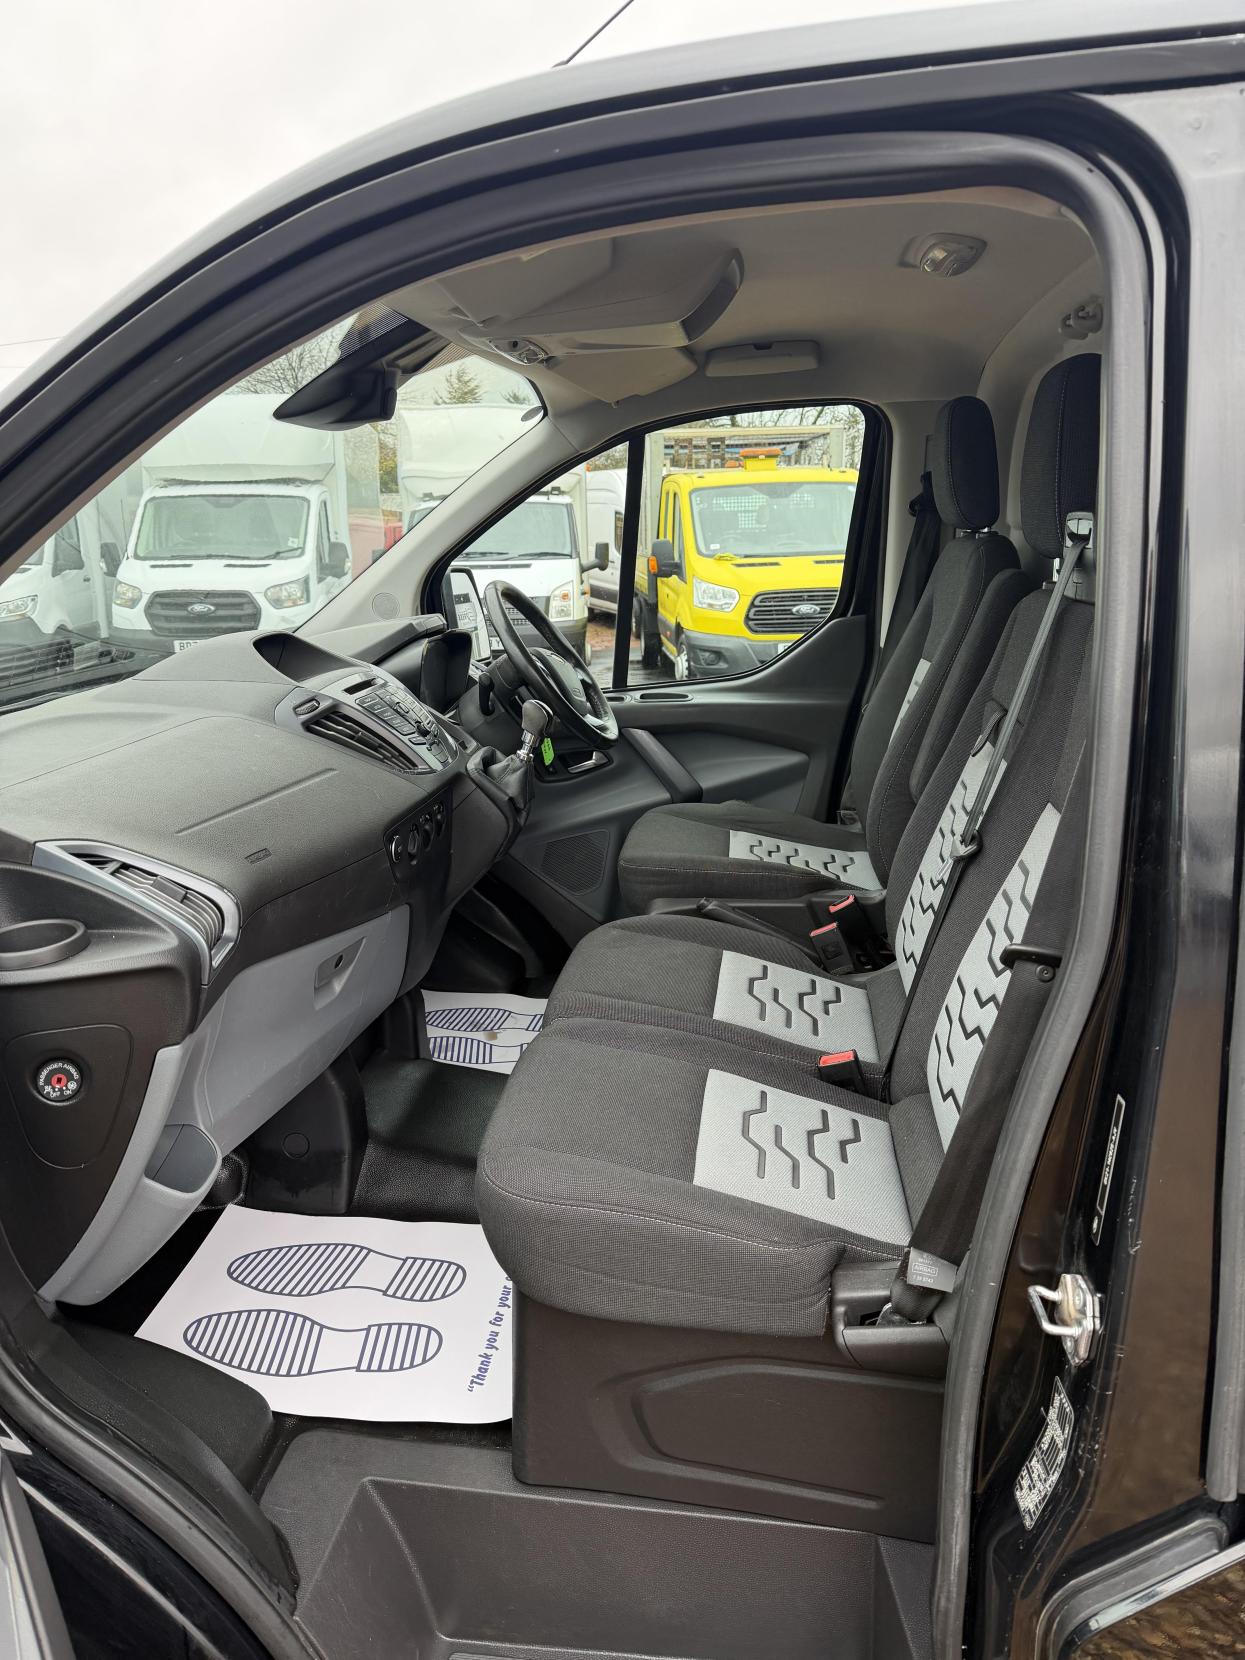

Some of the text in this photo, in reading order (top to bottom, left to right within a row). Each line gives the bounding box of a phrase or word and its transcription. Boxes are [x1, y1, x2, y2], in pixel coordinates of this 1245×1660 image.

[39, 1063, 79, 1086] PASSENGER AIRBAG
[497, 1284, 512, 1309] your
[488, 1311, 505, 1327] for
[485, 1330, 500, 1351] you
